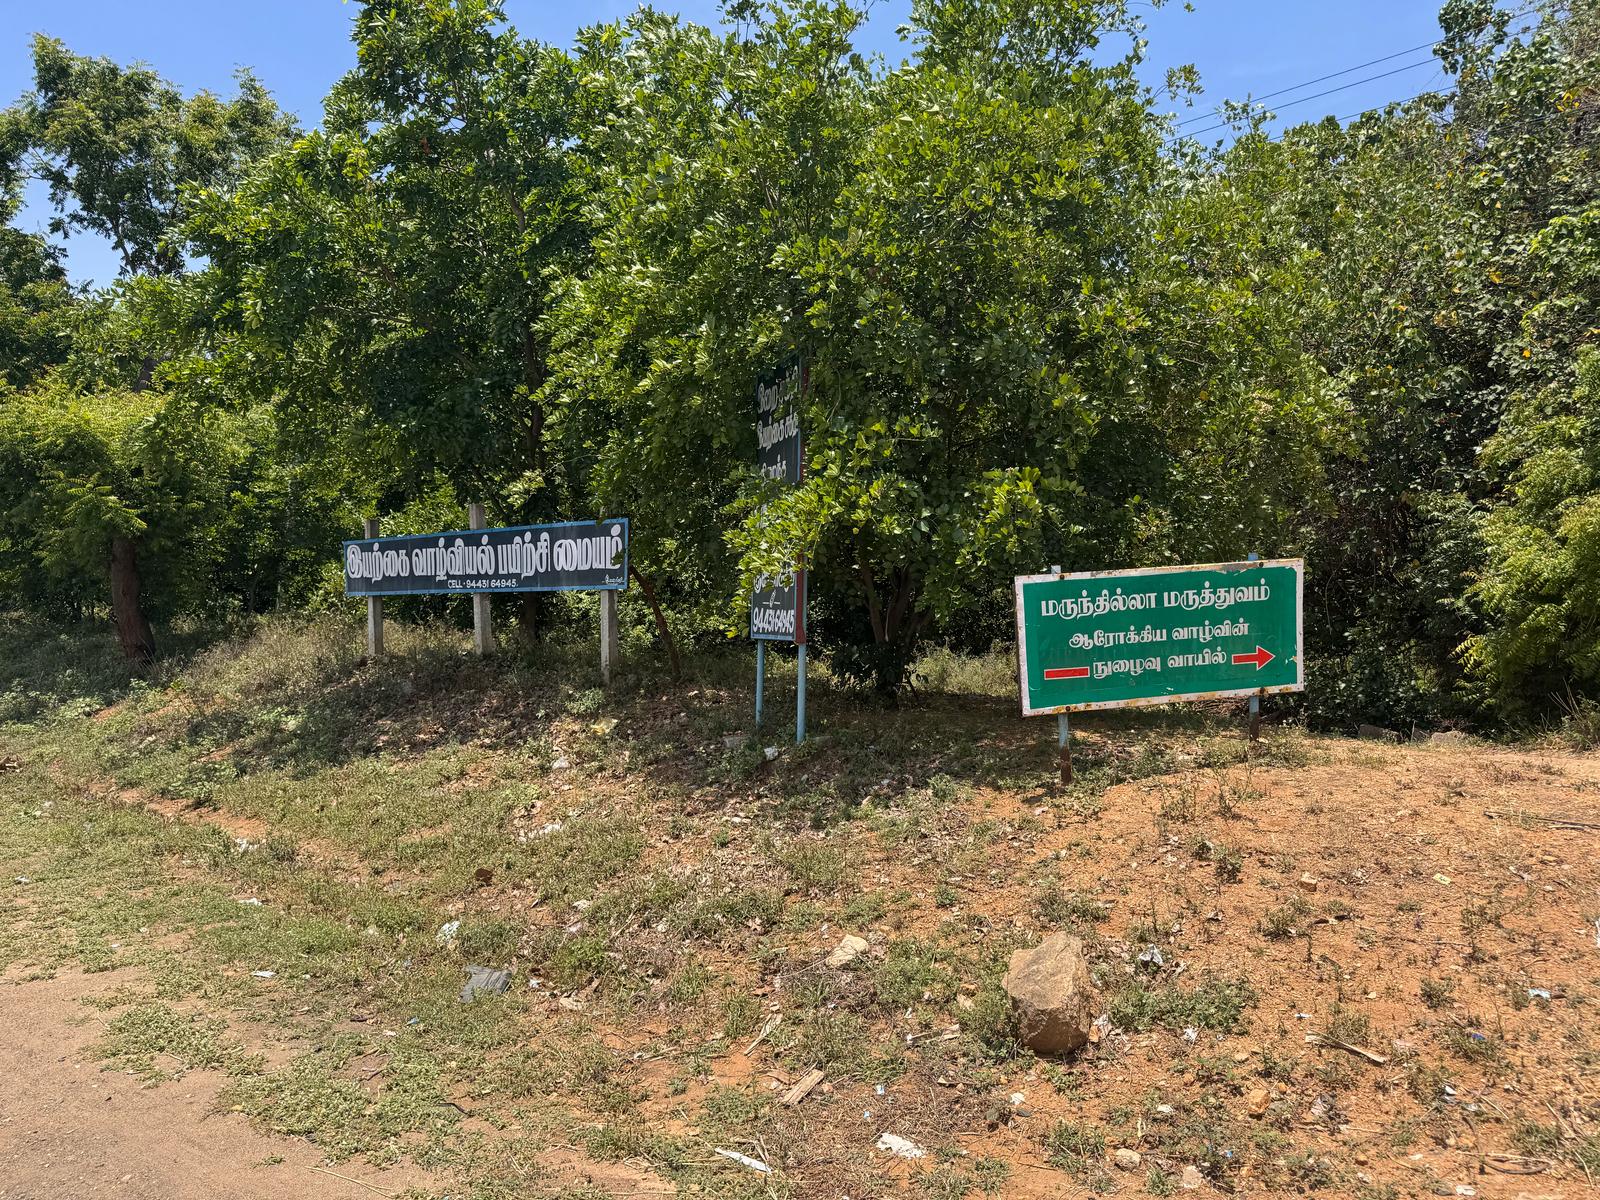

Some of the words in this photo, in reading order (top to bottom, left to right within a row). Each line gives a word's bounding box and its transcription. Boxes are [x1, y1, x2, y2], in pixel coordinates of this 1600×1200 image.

[346, 542, 410, 584] இயற்கை
[412, 534, 495, 582] வாழ்வியல்
[498, 531, 551, 580] பயிற்சி
[553, 524, 623, 572] மையம்
[1041, 588, 1158, 620] மருந்தில்லா
[1163, 578, 1271, 610] மருத்துவம்
[1069, 625, 1167, 650] ஆரோக்கிய
[1171, 617, 1250, 643] வாழ்வின்
[1093, 656, 1161, 679] நுழைவு
[1167, 646, 1227, 668] வாயில்
